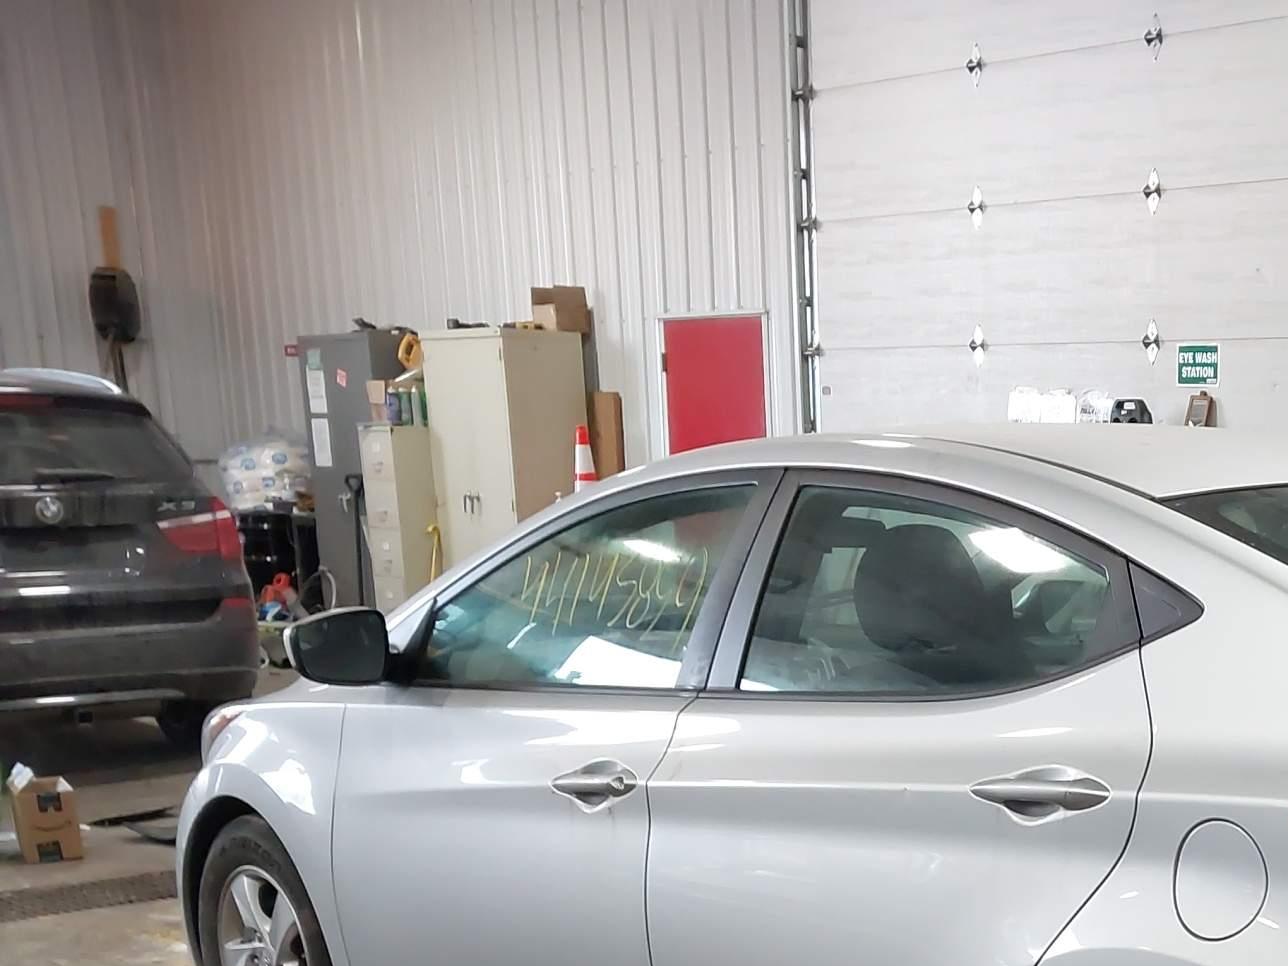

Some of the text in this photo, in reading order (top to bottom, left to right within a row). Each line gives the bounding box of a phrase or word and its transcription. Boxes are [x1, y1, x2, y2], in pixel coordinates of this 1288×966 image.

[1179, 351, 1217, 364] EYE WASH
[1181, 366, 1215, 378] STATION
